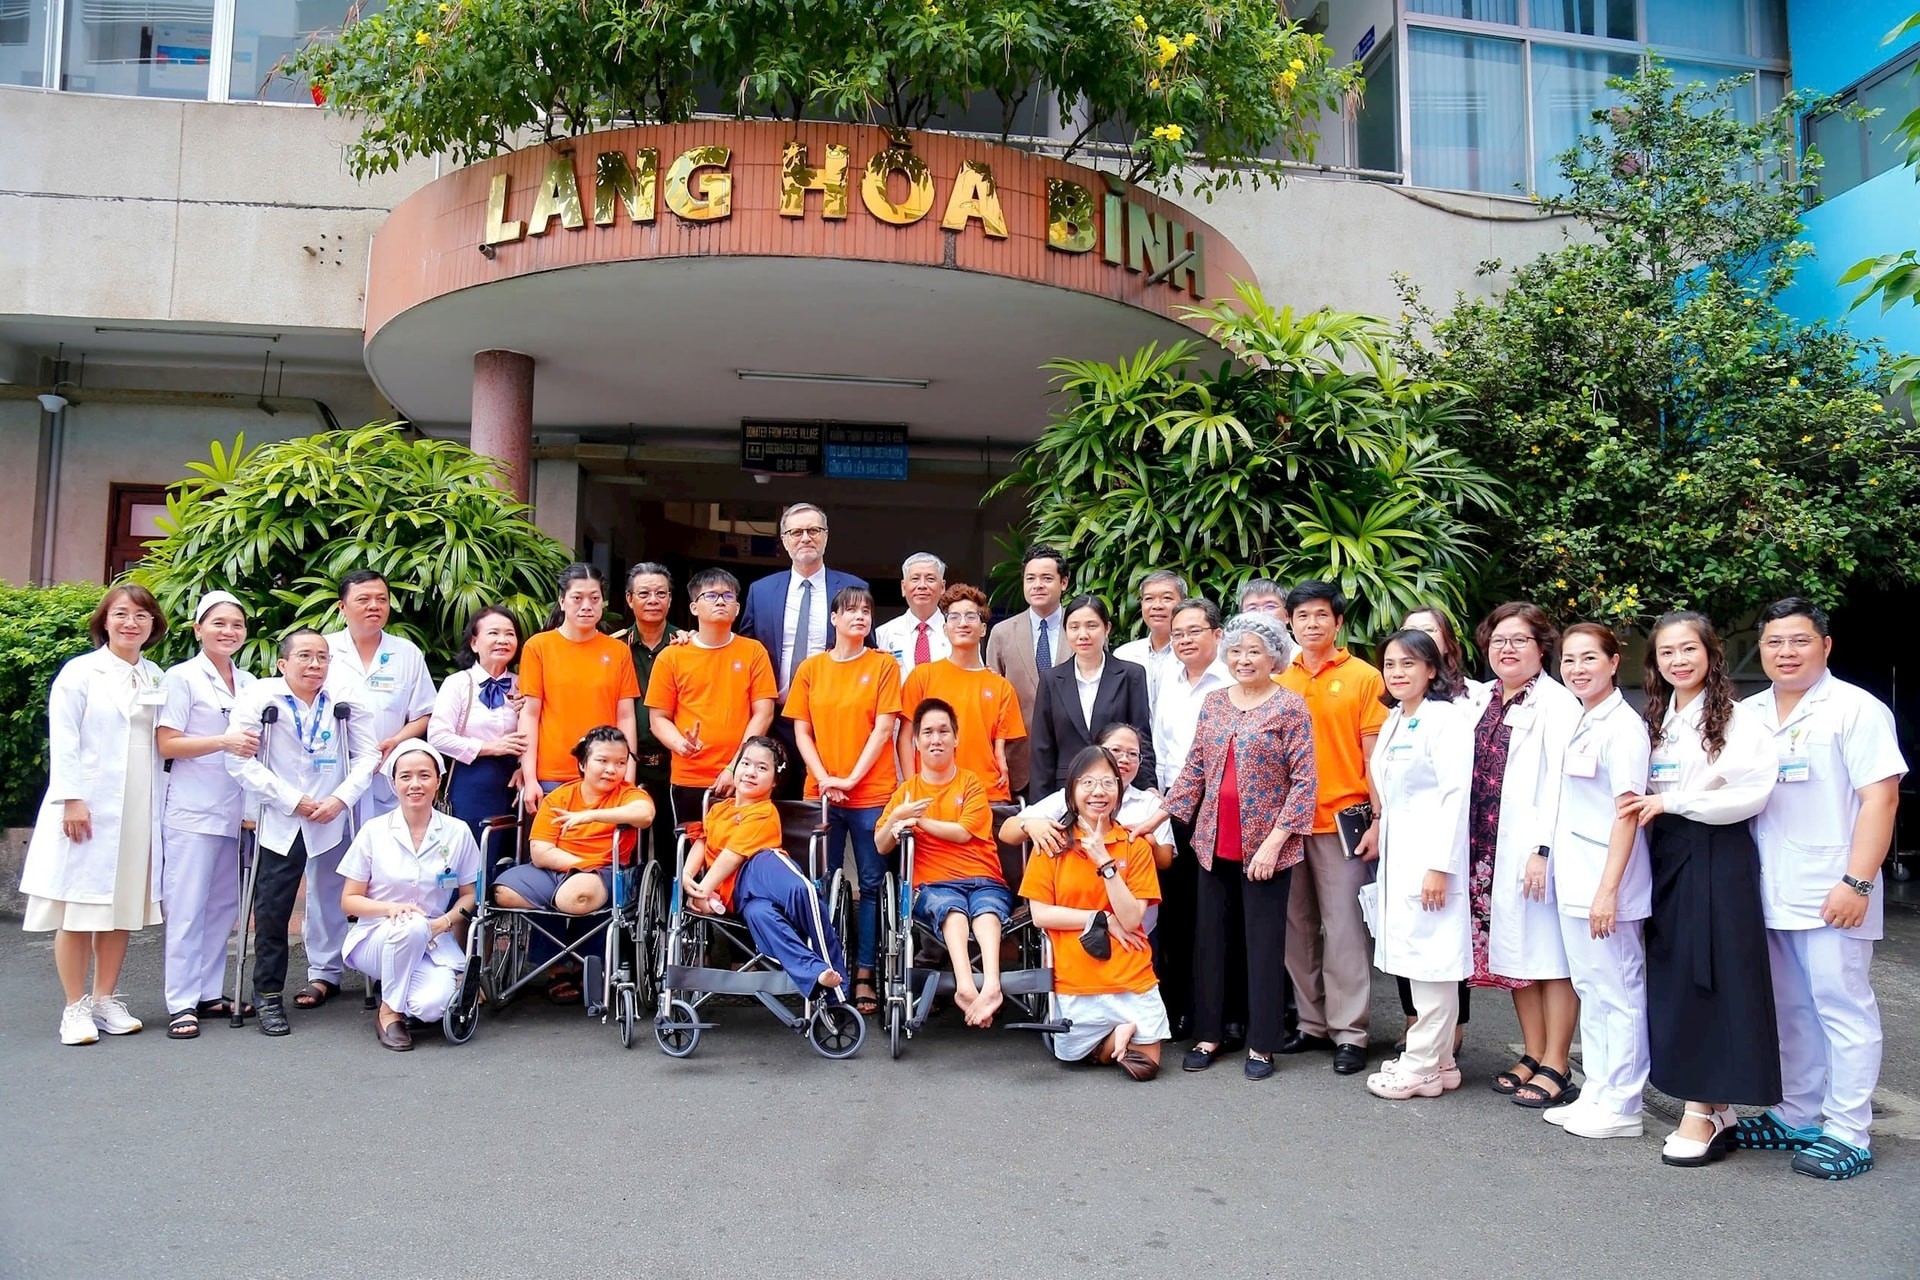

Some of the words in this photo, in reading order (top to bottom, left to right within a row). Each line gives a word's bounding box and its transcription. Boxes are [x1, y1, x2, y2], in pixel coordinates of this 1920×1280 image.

[779, 124, 1009, 240] HÒA
[1046, 170, 1207, 300] BÌNH
[768, 426, 782, 439] FROM
[783, 426, 798, 440] PEACE
[799, 427, 819, 440] VILLAGE
[765, 442, 796, 455] OBERHAUSEN
[796, 443, 818, 456] GERMANY
